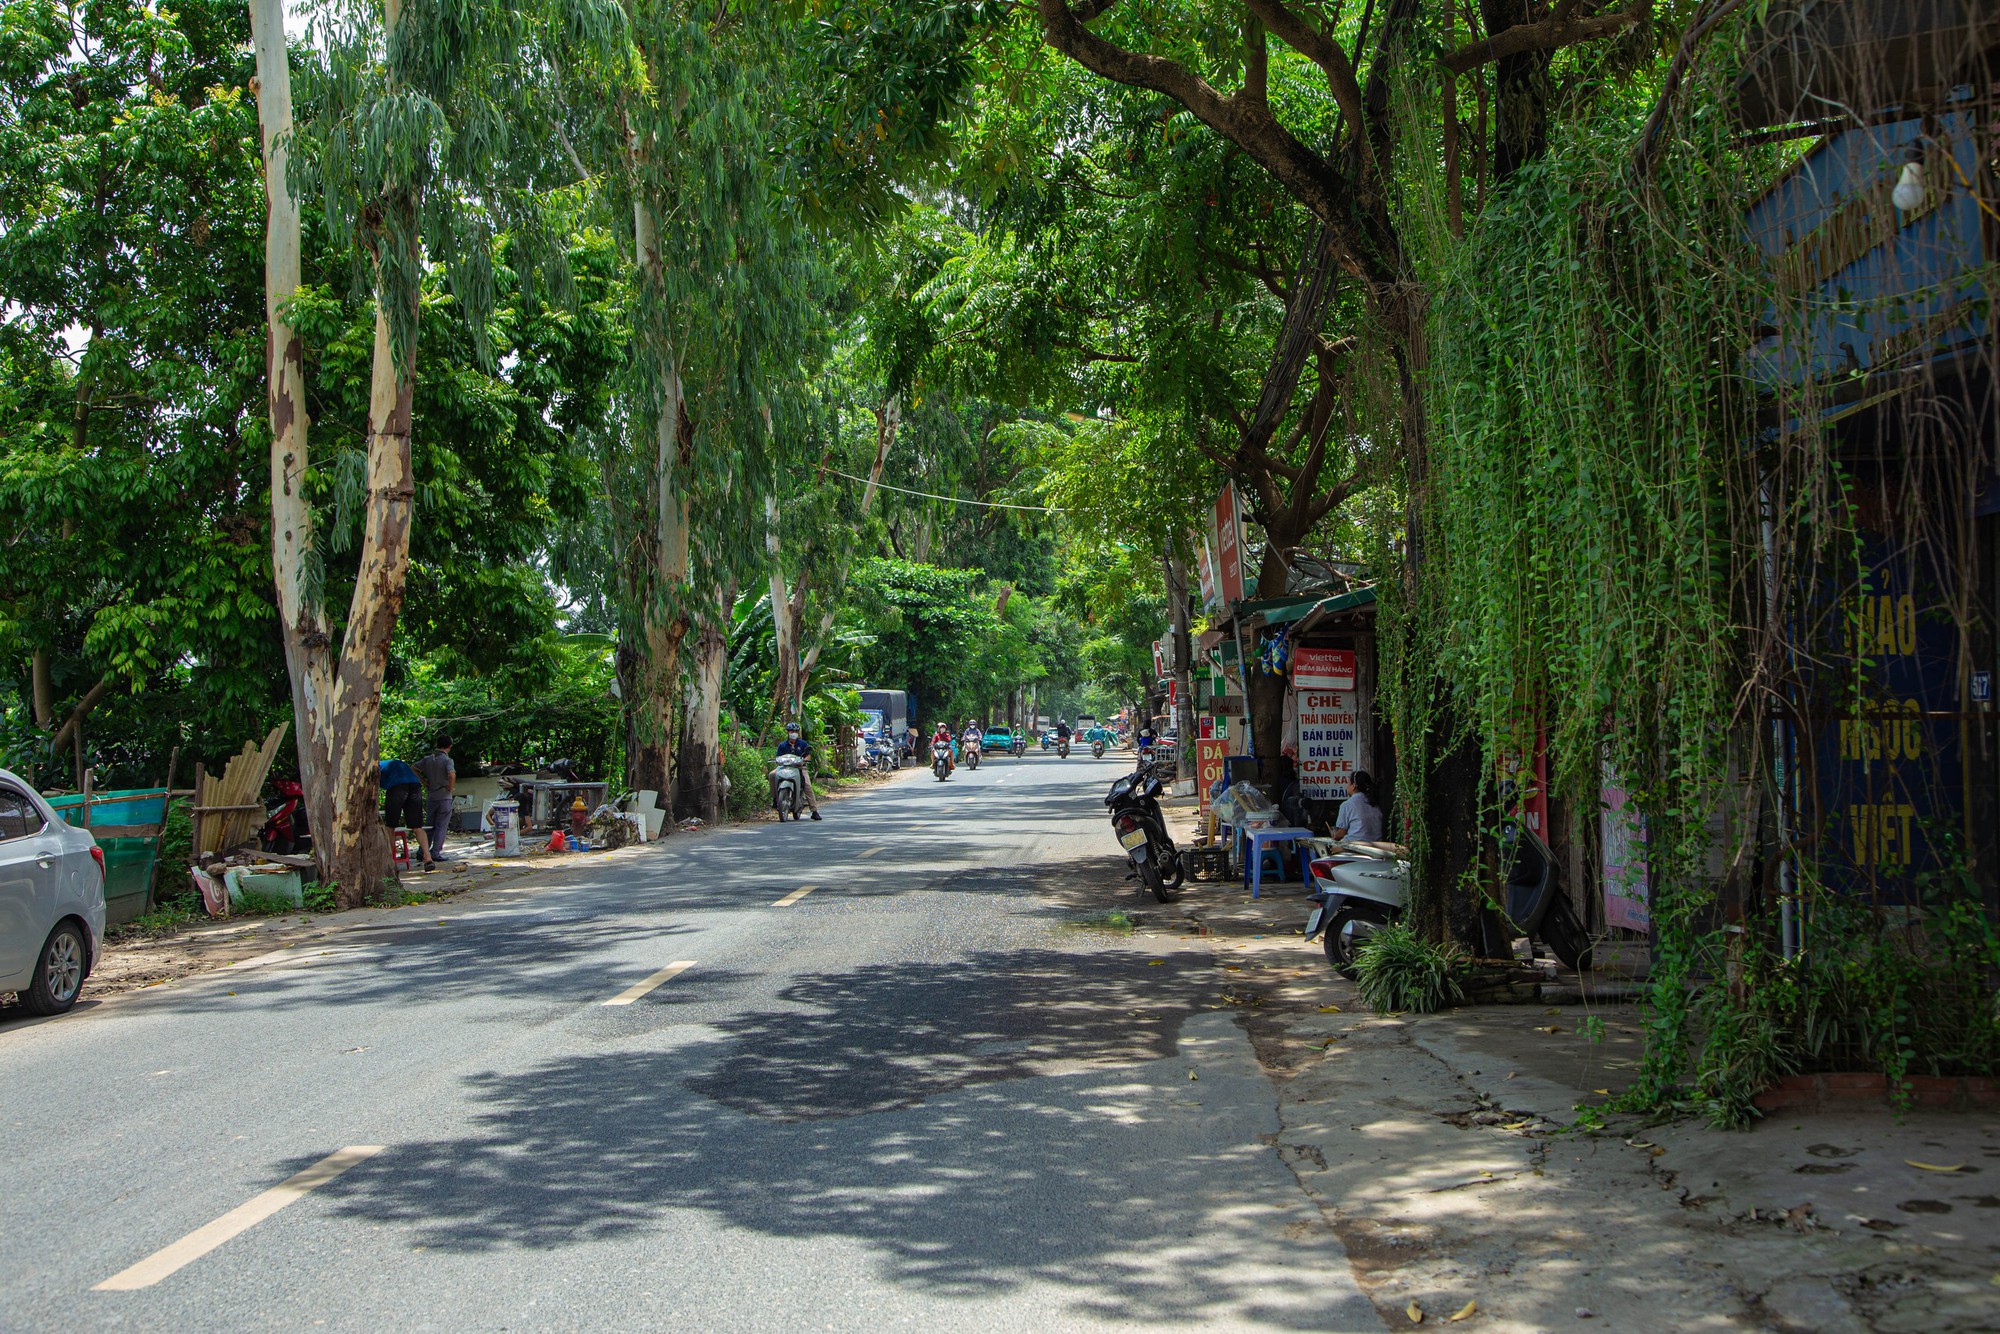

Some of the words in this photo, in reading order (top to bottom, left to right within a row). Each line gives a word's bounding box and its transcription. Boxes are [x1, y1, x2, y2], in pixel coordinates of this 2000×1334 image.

[1309, 654, 1343, 662] viettel
[1316, 664, 1331, 672] BÁN
[1300, 710, 1319, 724] THÁI
[1321, 710, 1354, 724] NGUYÊN
[1302, 728, 1323, 741] BÁN
[1326, 728, 1353, 741] BUÔN
[1203, 743, 1223, 760] ĐÁ
[1309, 744, 1330, 757] BÁN
[1333, 743, 1344, 757] LẺ
[1302, 776, 1331, 785] RANG
[1334, 776, 1348, 785] XA
